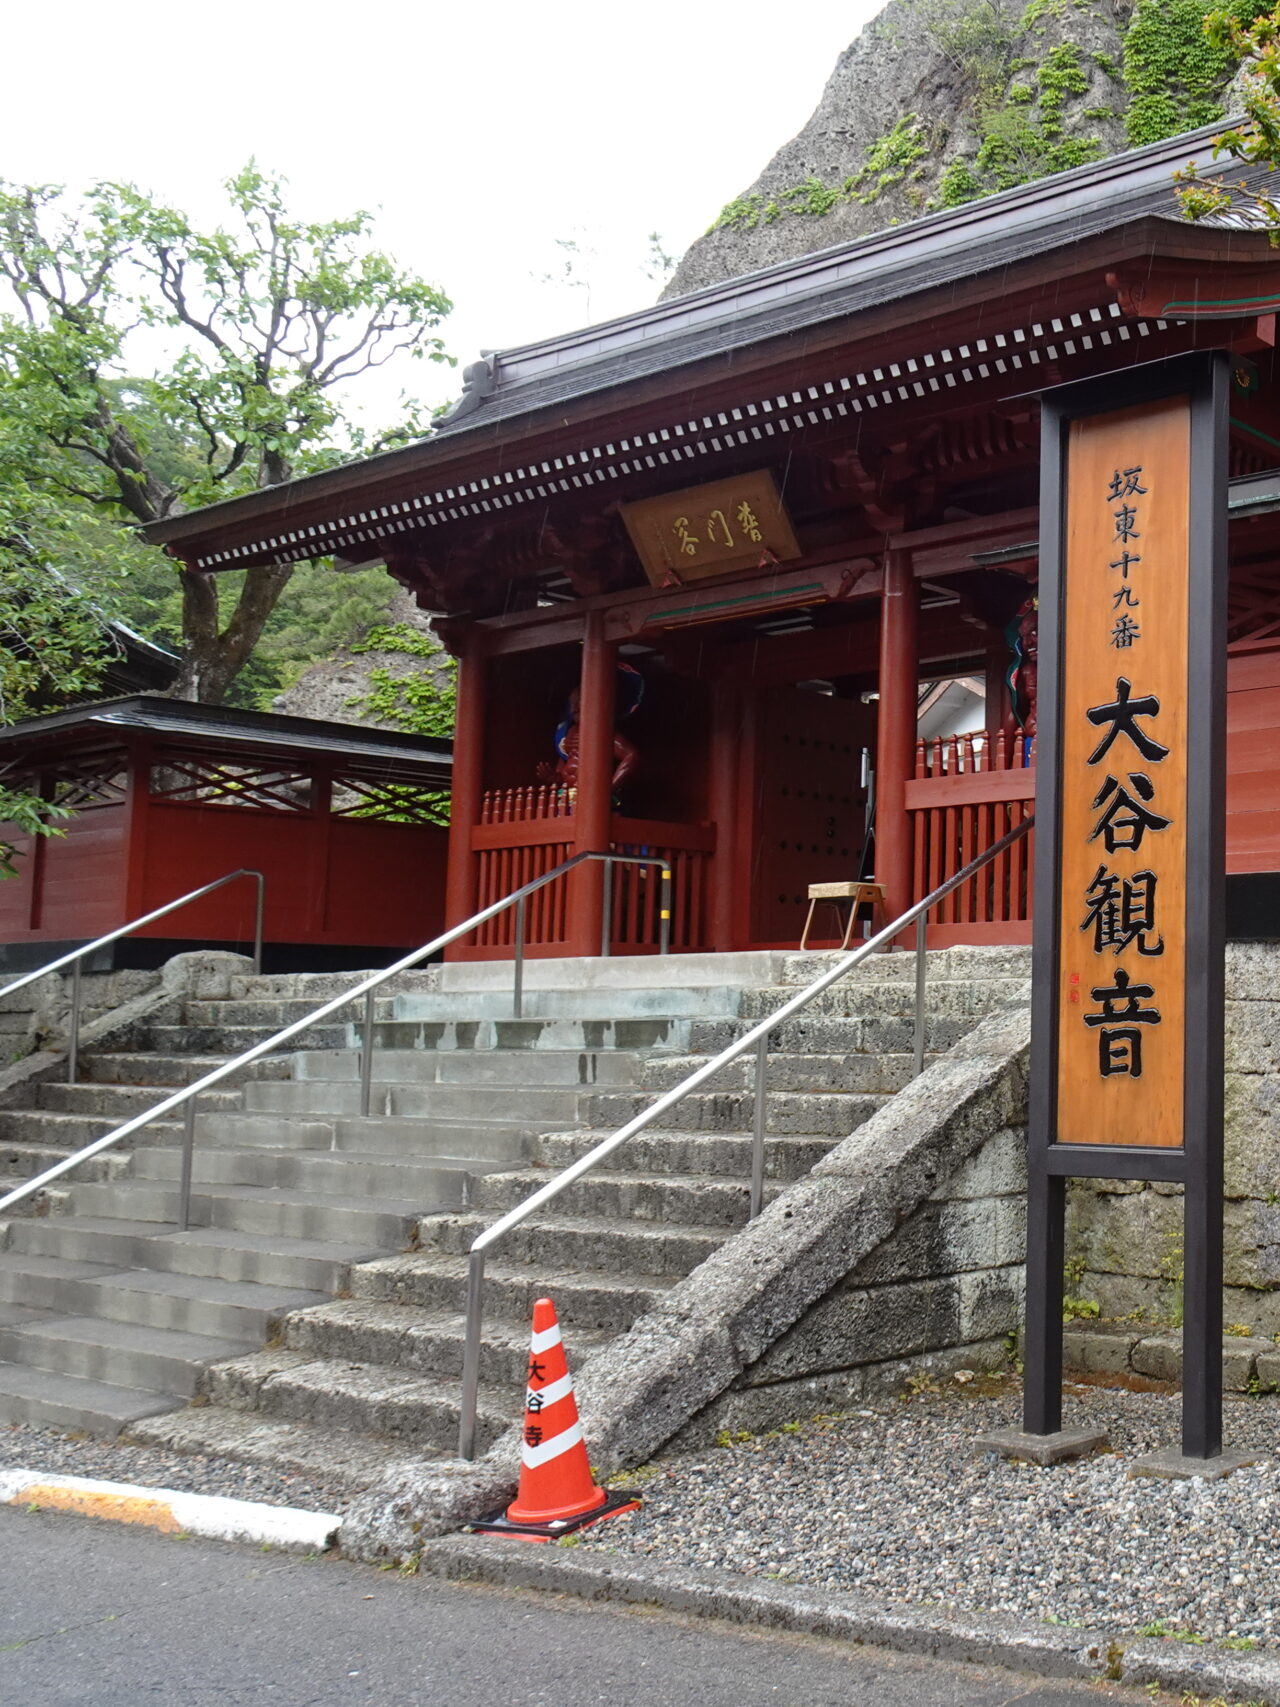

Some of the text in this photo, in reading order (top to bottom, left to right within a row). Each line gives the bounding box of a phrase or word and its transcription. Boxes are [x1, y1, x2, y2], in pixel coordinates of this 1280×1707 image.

[1106, 464, 1148, 650] 坂東十九番
[1079, 675, 1174, 1080] 大谷観音
[526, 1361, 545, 1448] 大谷寺
